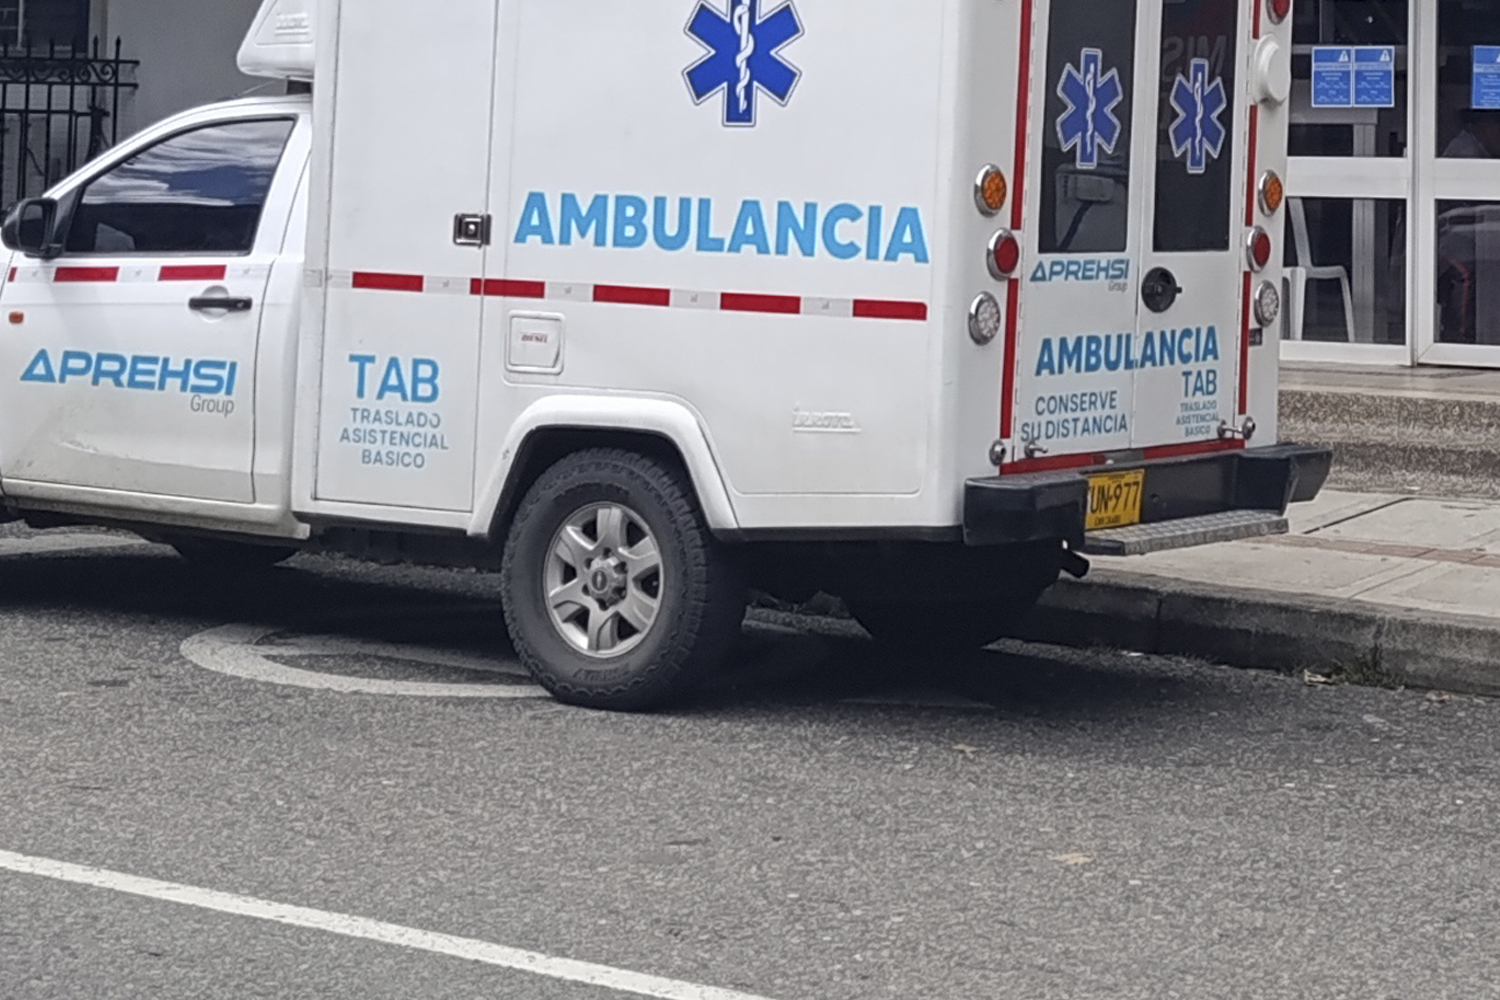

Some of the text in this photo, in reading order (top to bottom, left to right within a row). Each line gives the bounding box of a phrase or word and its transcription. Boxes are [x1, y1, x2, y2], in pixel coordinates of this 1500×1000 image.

[513, 190, 930, 264] AMBULANCIA
[1028, 258, 1131, 282] APREHSI
[1034, 325, 1220, 377] AMBULANCIA
[20, 348, 238, 396] APREHSI
[348, 353, 440, 404] TAB
[1181, 368, 1218, 398] TAB
[190, 393, 236, 418] Group
[1035, 390, 1118, 416] CONSERVE
[350, 407, 442, 430] TRASLADO
[1020, 413, 1128, 442] SU DISTANCIA
[339, 427, 450, 451] ASISTENCIAL
[361, 448, 426, 469] BASICO
